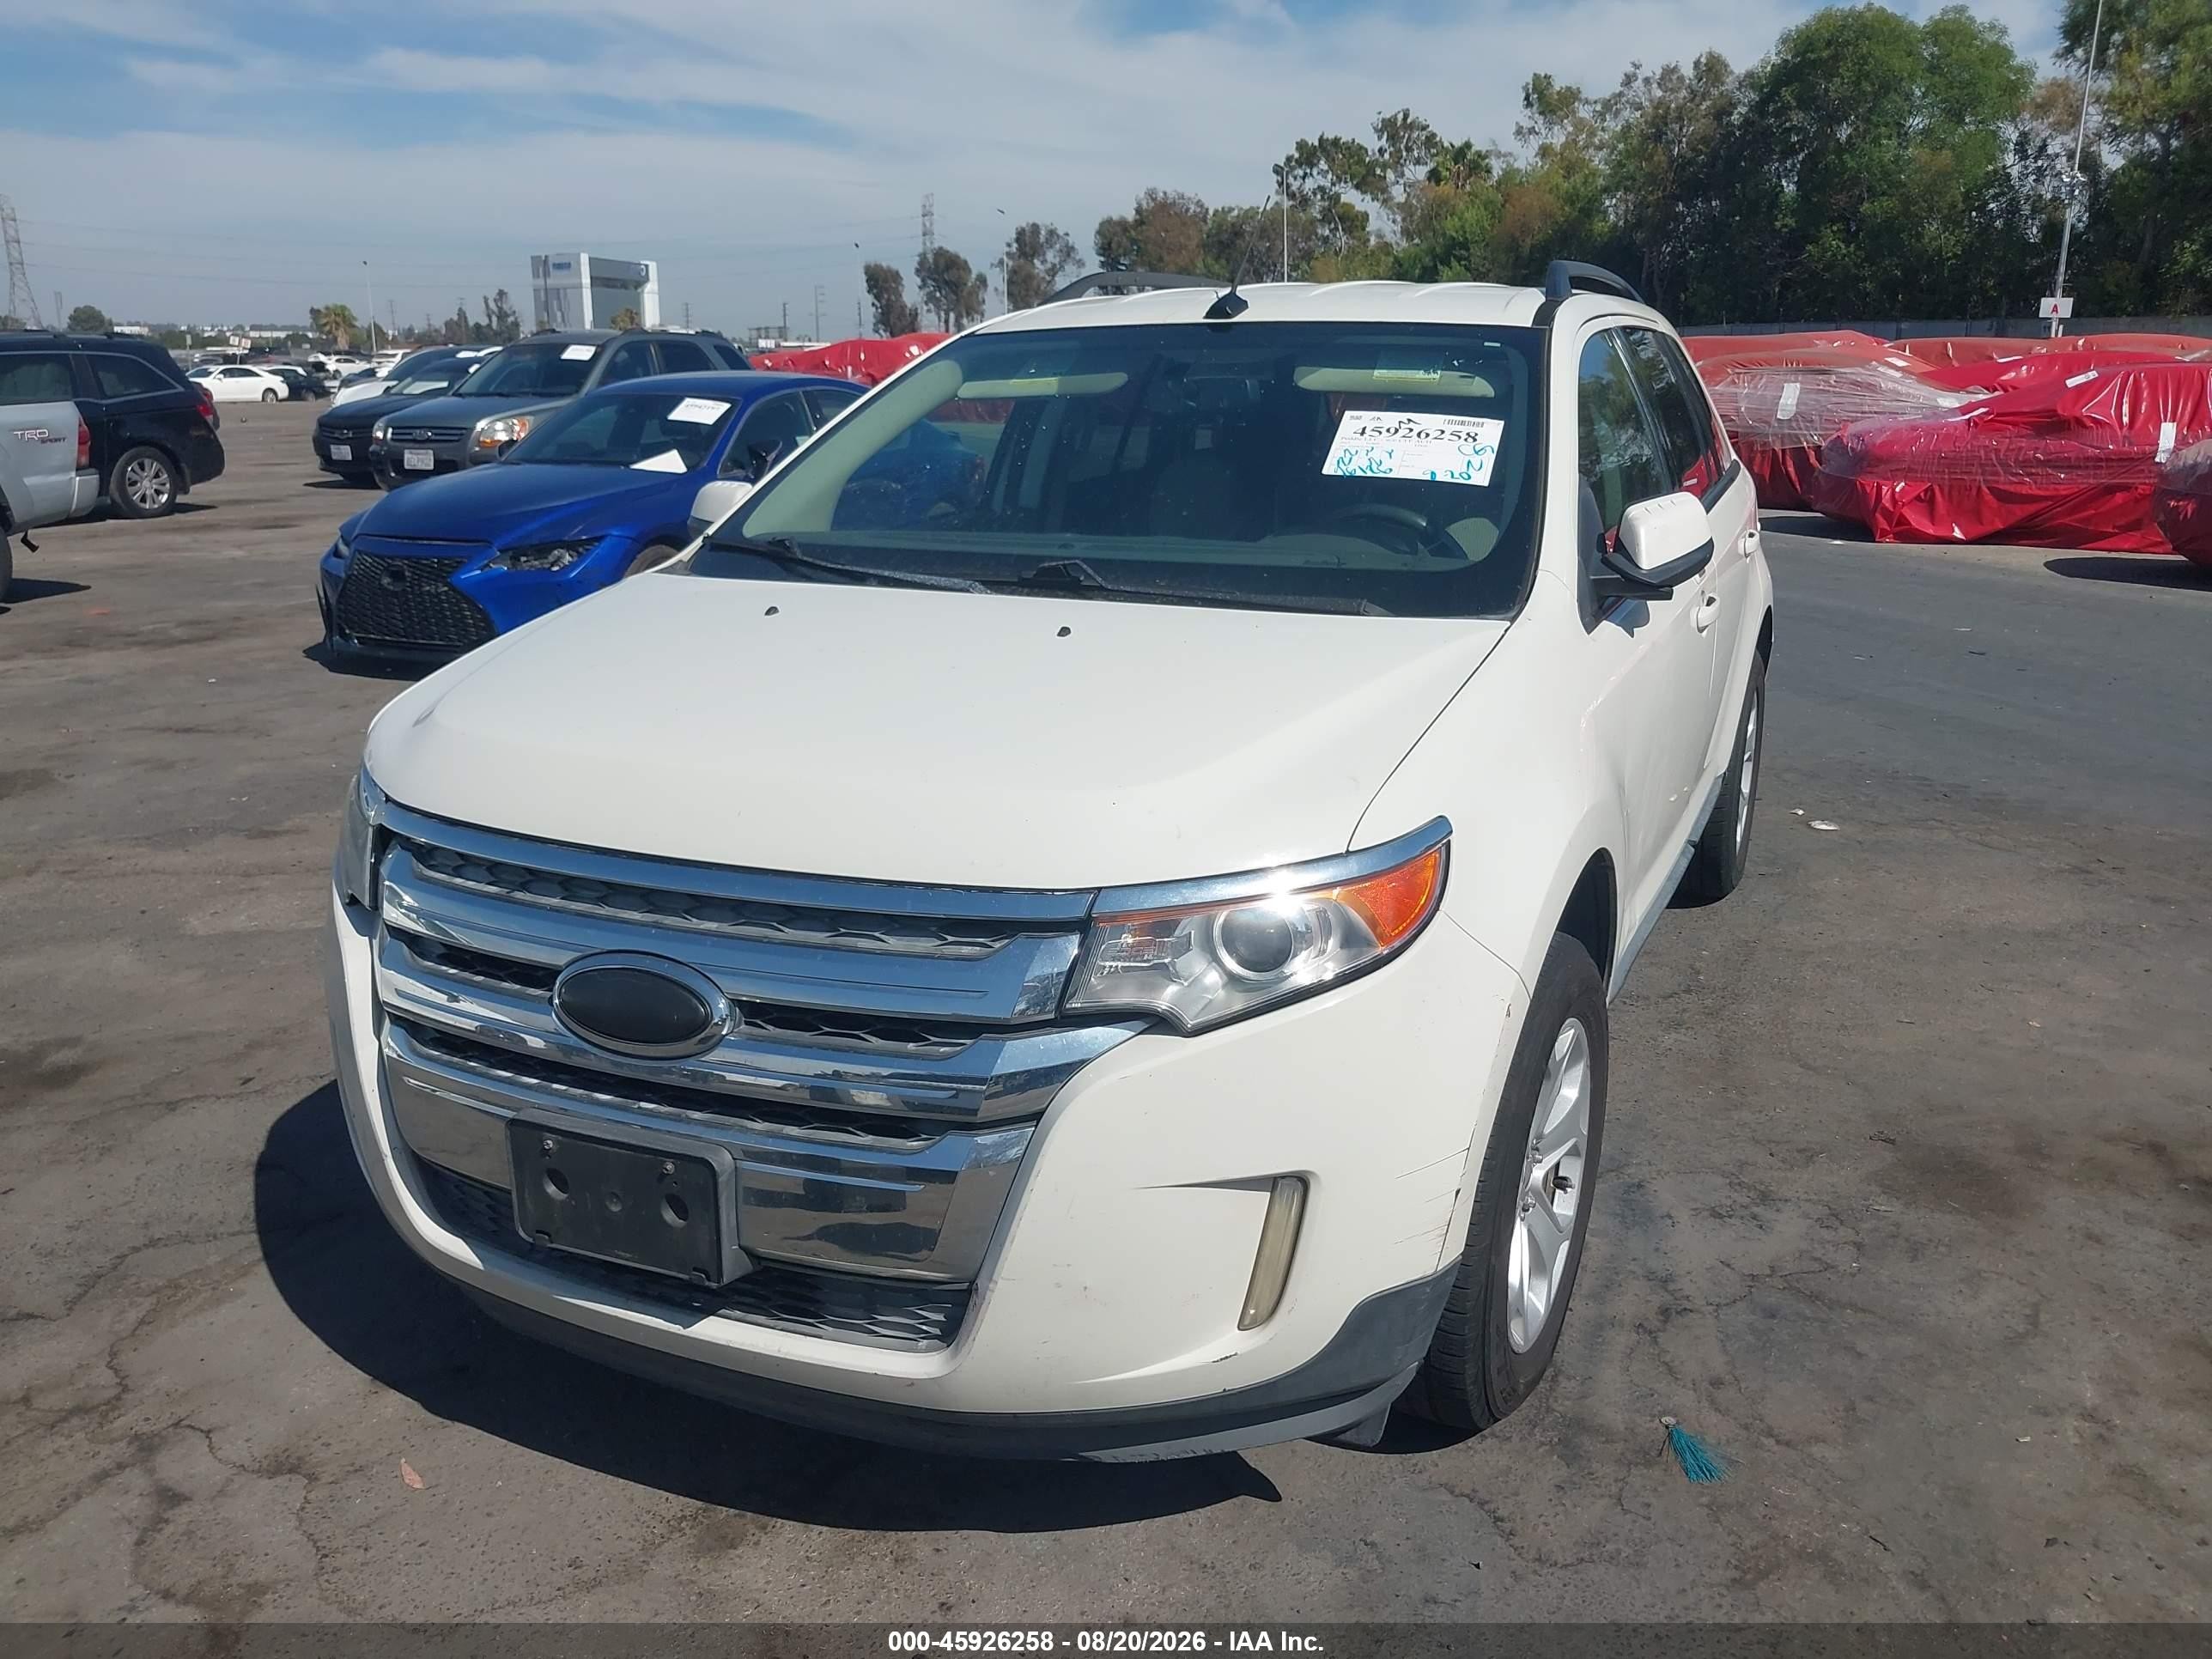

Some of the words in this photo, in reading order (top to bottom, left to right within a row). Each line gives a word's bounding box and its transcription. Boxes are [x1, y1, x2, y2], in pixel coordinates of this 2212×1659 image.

[2051, 303, 2059, 314] A
[13, 428, 49, 441] TRD
[1352, 425, 1479, 444] 45926258
